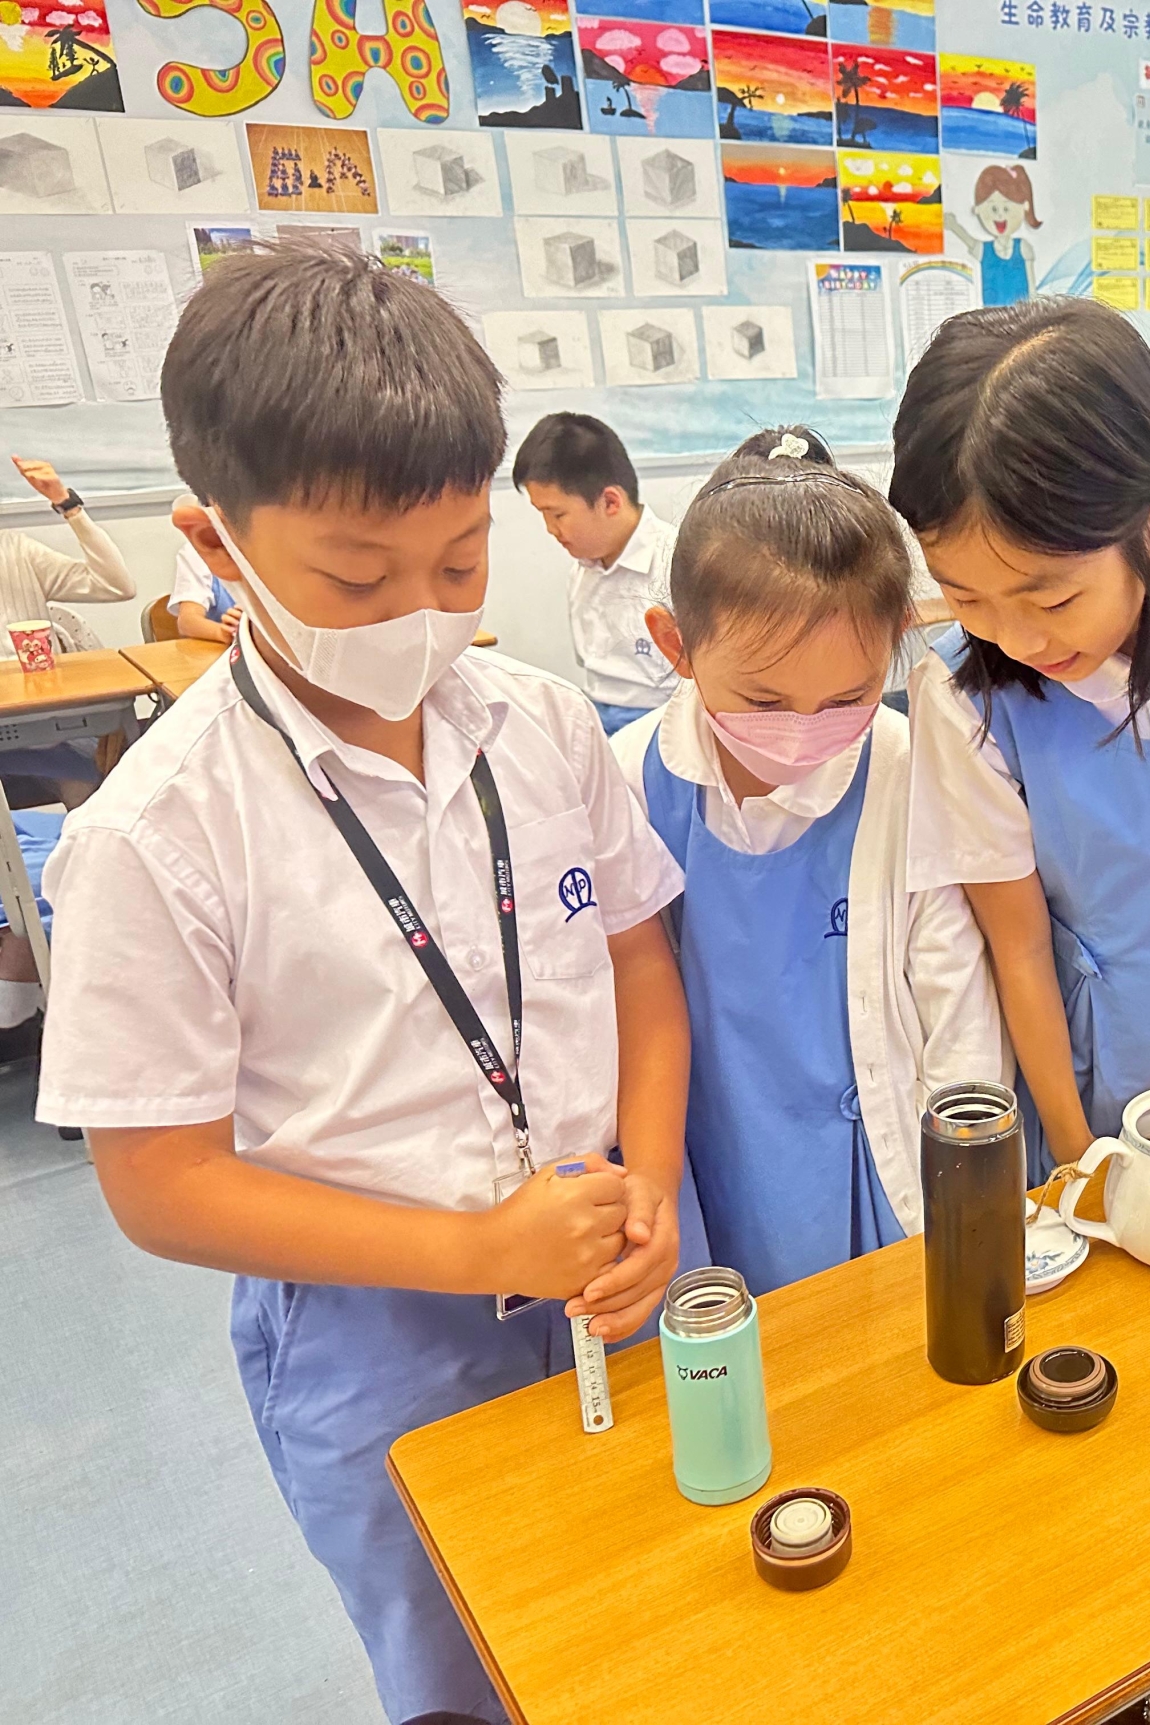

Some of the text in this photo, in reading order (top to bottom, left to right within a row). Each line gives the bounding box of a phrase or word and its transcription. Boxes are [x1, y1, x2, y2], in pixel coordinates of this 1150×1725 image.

[829, 268, 868, 280] HAPPY
[823, 280, 876, 291] BIRTHDAY
[388, 898, 415, 932] 城市汽車
[470, 1039, 494, 1070] 城市汽車
[689, 1365, 728, 1380] VACA
